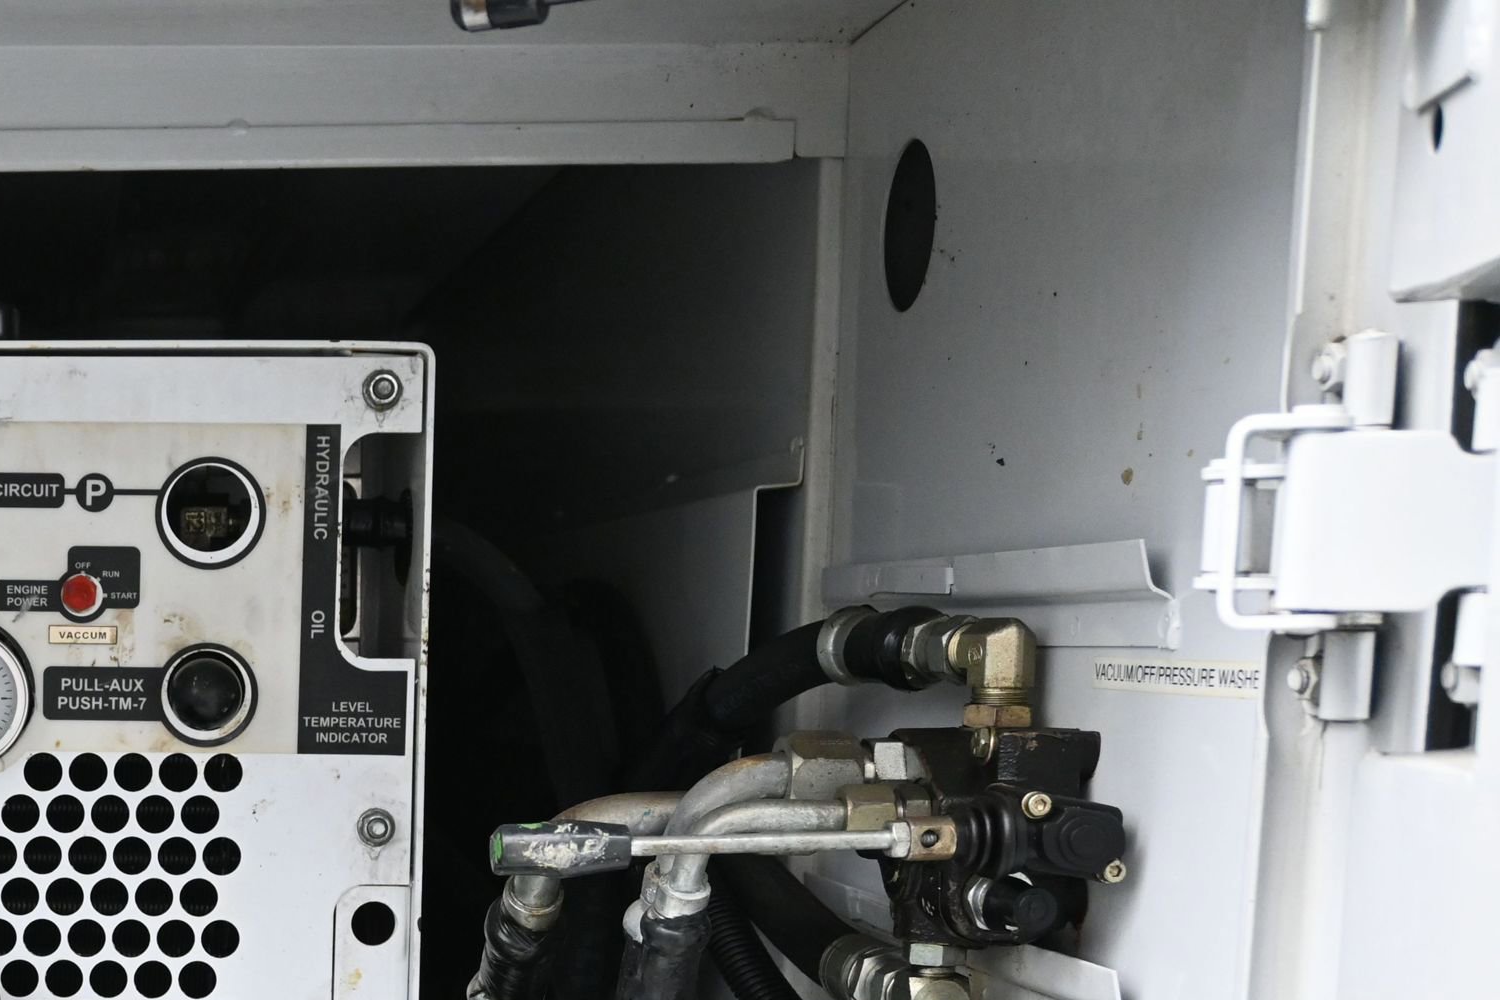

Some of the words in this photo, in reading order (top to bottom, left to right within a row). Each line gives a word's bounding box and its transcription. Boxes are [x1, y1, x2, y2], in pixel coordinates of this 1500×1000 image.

[85, 479, 106, 506] P
[314, 436, 330, 540] HYDRAULIC
[102, 570, 120, 578] RUN
[6, 585, 48, 595] ENGINE
[6, 597, 48, 607] POWER
[311, 610, 325, 639] OIL
[59, 631, 107, 640] VACCUM
[1094, 663, 1216, 687] VACUUM/OFF/PRESSURE
[61, 678, 144, 692] PULL-AUX
[57, 696, 147, 710] PUSH-TM-7
[332, 702, 373, 713] LEVEL
[303, 716, 401, 729] TEMPERATURE
[315, 732, 388, 744] INDICATOR
